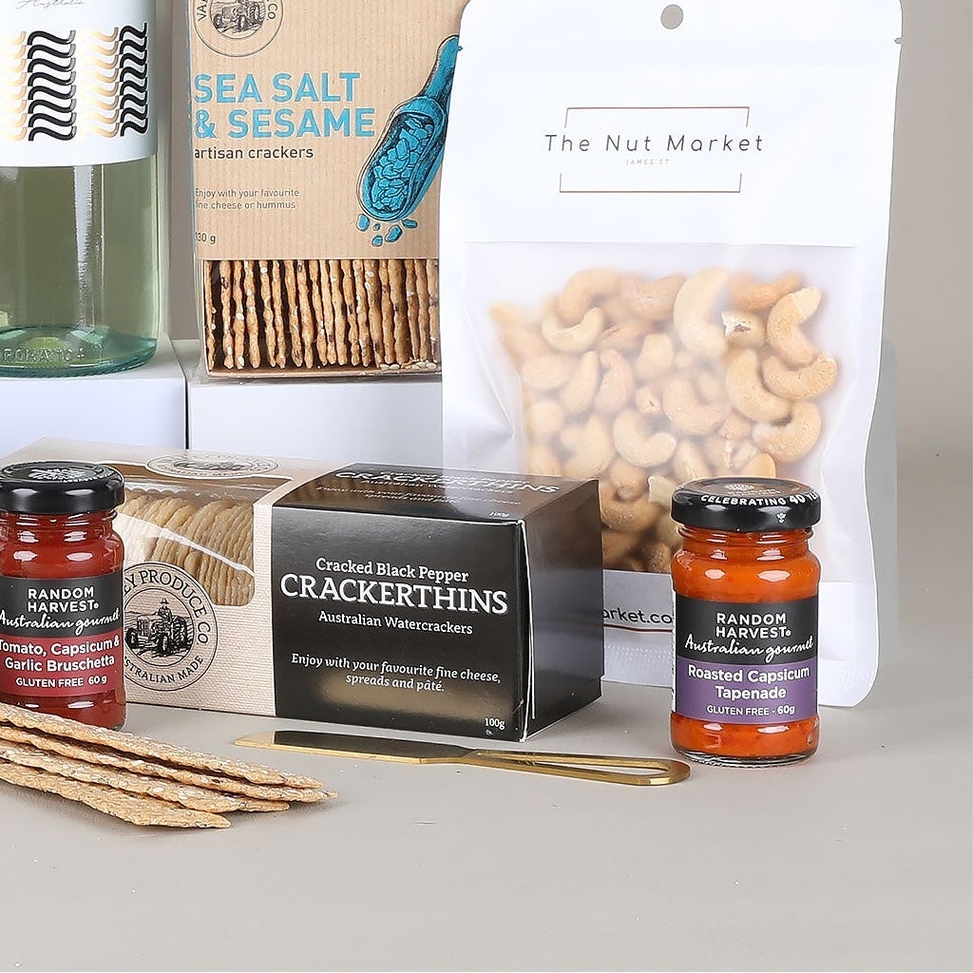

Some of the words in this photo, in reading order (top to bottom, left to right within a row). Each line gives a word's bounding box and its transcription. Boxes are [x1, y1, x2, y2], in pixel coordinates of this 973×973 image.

[194, 73, 262, 104] SEA
[272, 72, 360, 103] SALT
[195, 109, 216, 138] &
[228, 108, 375, 138] SESAME
[545, 134, 590, 152] The
[605, 134, 651, 152] Nut
[667, 134, 763, 152] Market
[194, 147, 243, 159] artisan
[248, 146, 314, 159] crackers
[195, 188, 216, 199] Enjoy
[217, 189, 237, 197] with
[239, 190, 258, 199] your
[260, 189, 299, 197] favourite
[211, 201, 242, 209] cheese
[256, 201, 296, 209] hummus
[210, 235, 216, 244] g
[701, 494, 787, 506] CELEBRATING
[789, 494, 806, 505] 40
[316, 558, 373, 574] Cracked
[376, 562, 415, 578] Black
[419, 566, 468, 584] Pepper
[28, 587, 94, 599] RANDOM
[140, 569, 207, 619] PRODUCE
[281, 574, 508, 614] CRACKERTHINS
[75, 607, 120, 636] gourmet
[319, 611, 381, 627] Australian
[384, 616, 473, 635] Watercrackers
[717, 613, 786, 625] RANDOM
[51, 640, 112, 657] Capsicum
[114, 636, 120, 647] &
[684, 634, 764, 656] Australian
[764, 636, 813, 663] gourmet
[4, 657, 42, 671] Garlic
[47, 654, 115, 672] Bruschetta
[177, 656, 204, 681] MADE
[291, 653, 323, 669] Enjoy
[325, 656, 350, 669] with
[352, 660, 379, 674] your
[381, 660, 433, 677] favourite
[435, 665, 458, 679] fine
[460, 669, 501, 683] cheese,
[16, 677, 55, 687] GLUTEN
[59, 678, 84, 687] FREE
[88, 677, 100, 686] 60
[346, 674, 390, 689] spreads
[392, 677, 414, 689] and
[416, 679, 444, 692] pâté.
[688, 665, 742, 682] Roasted
[748, 666, 809, 683] Capsicum
[715, 686, 787, 702] Tapenade
[707, 706, 743, 715] GLUTEN
[746, 706, 769, 716] FREE
[777, 705, 795, 716] 60g
[484, 718, 505, 730] 100g
